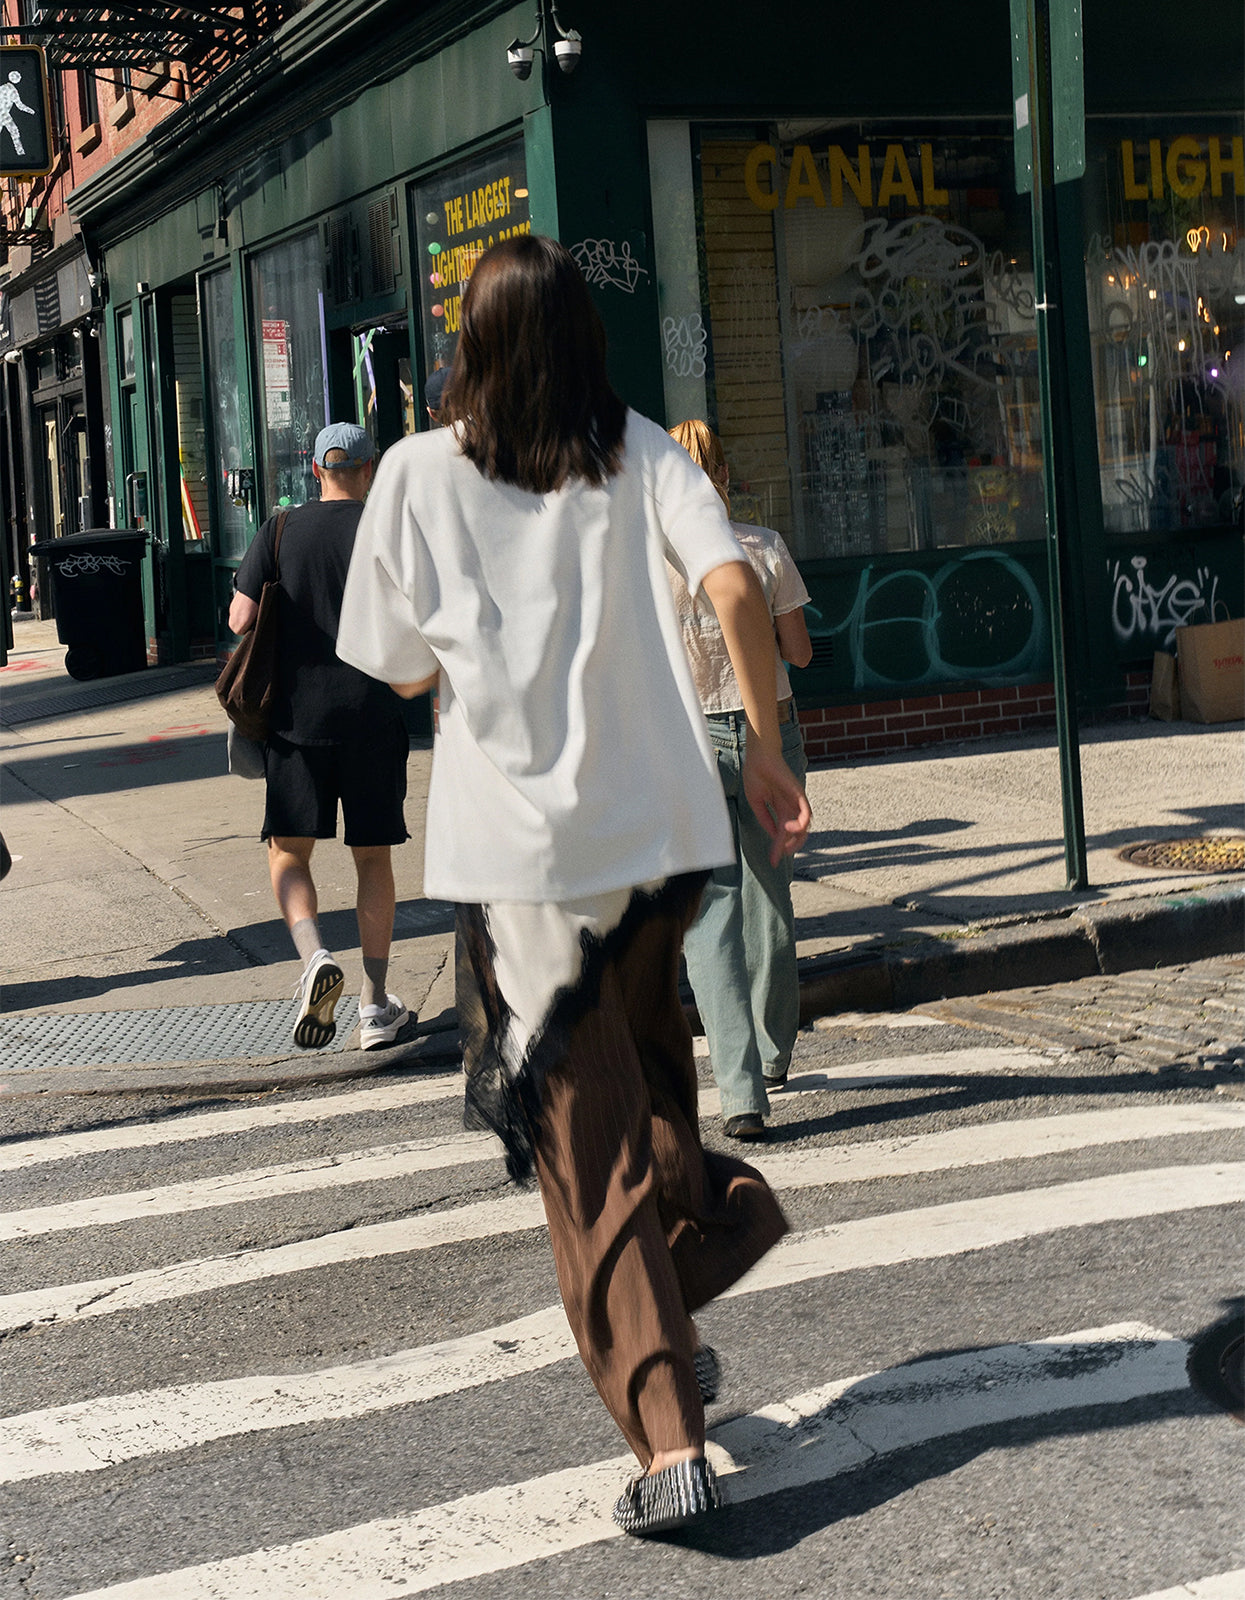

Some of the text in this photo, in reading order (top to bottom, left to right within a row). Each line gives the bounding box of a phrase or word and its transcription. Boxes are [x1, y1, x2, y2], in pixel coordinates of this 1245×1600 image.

[744, 143, 949, 211] CANAL
[1121, 136, 1245, 200] LIGH
[444, 196, 464, 236] THE
[465, 176, 511, 230] LARGEST
